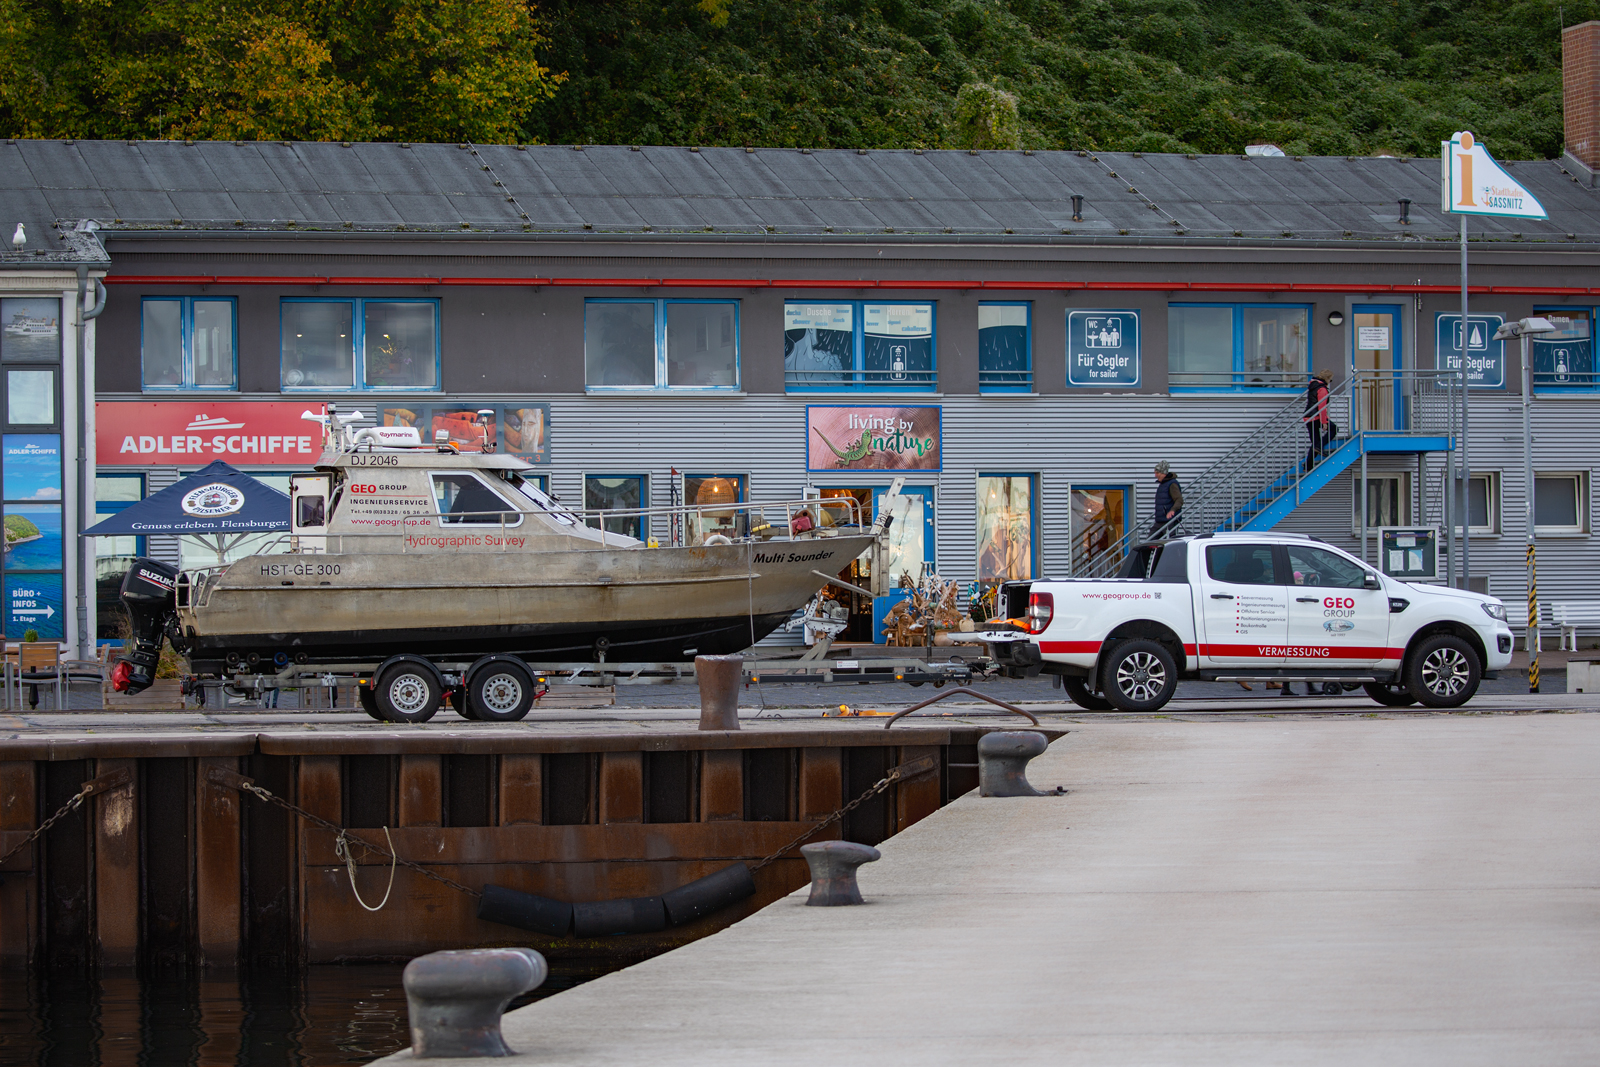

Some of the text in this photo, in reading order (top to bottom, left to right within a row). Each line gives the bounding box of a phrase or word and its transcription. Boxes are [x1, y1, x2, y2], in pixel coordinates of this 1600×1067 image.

[1489, 196, 1523, 210] SASSNITZ
[806, 307, 832, 316] Dusche
[886, 306, 911, 316] Herren
[1547, 314, 1570, 323] Damen
[1087, 320, 1099, 329] WC
[1077, 353, 1130, 370] Für Segler
[1446, 355, 1496, 372] Für Segler
[1088, 369, 1119, 378] for sailor
[1466, 370, 1485, 380] sailor
[848, 413, 914, 435] living by
[379, 431, 413, 439] Raymarine
[119, 435, 312, 453] ADLER-SCHIFFE
[872, 427, 935, 457] nature
[351, 455, 399, 466] DJ 2046
[535, 454, 541, 462] 3
[350, 483, 377, 494] GEO
[349, 498, 429, 506] INGENIEURSERVICE
[131, 519, 289, 530] Genuss erleben. Flensburger.
[350, 518, 432, 528] www.geogroup.de
[405, 534, 526, 549] Hydrographic Survey
[753, 553, 786, 563] Multi
[787, 551, 835, 563] Sounder
[260, 564, 341, 576] HST-GE 300
[12, 587, 35, 598] BÜRO
[1082, 592, 1151, 600] www.geogroup.de
[12, 600, 37, 608] INFOS
[1323, 597, 1355, 609] GEO
[19, 615, 37, 623] Etage
[1323, 609, 1355, 618] GROUP
[1258, 646, 1330, 657] VERMESSUNG
